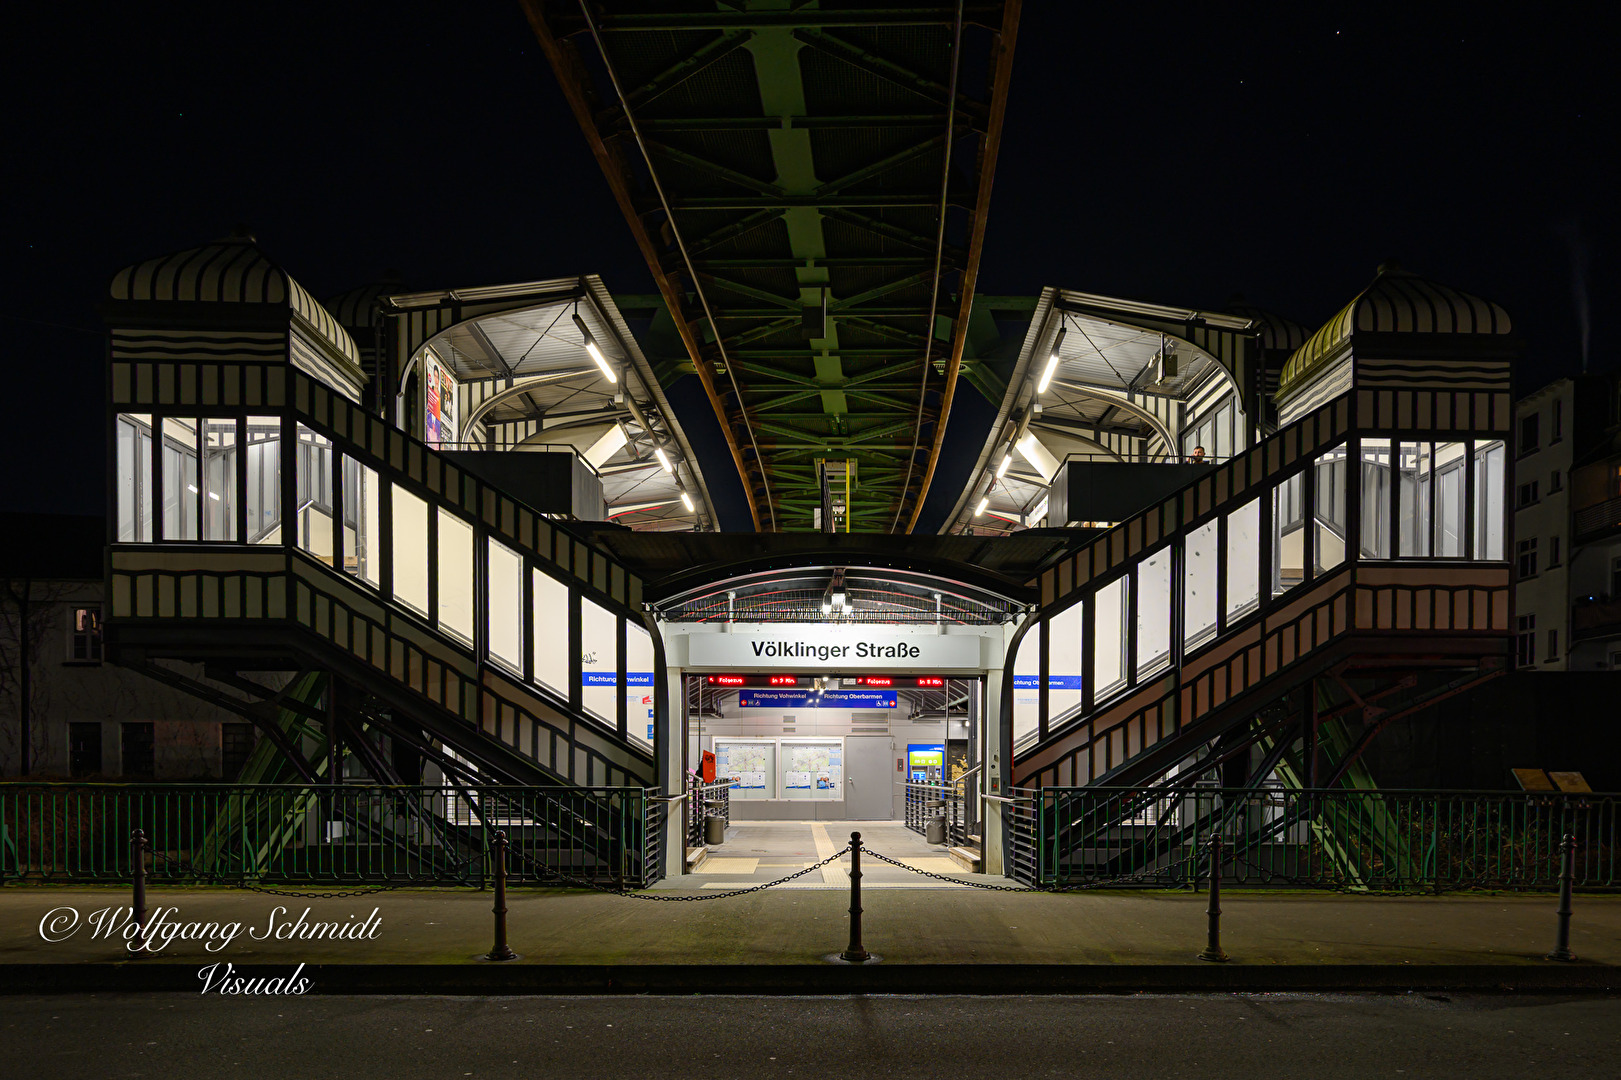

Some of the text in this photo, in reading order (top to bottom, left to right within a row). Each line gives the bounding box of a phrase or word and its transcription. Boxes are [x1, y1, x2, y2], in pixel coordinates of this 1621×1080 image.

[751, 641, 921, 661] Völklinger Straße
[588, 675, 617, 683] Richtung
